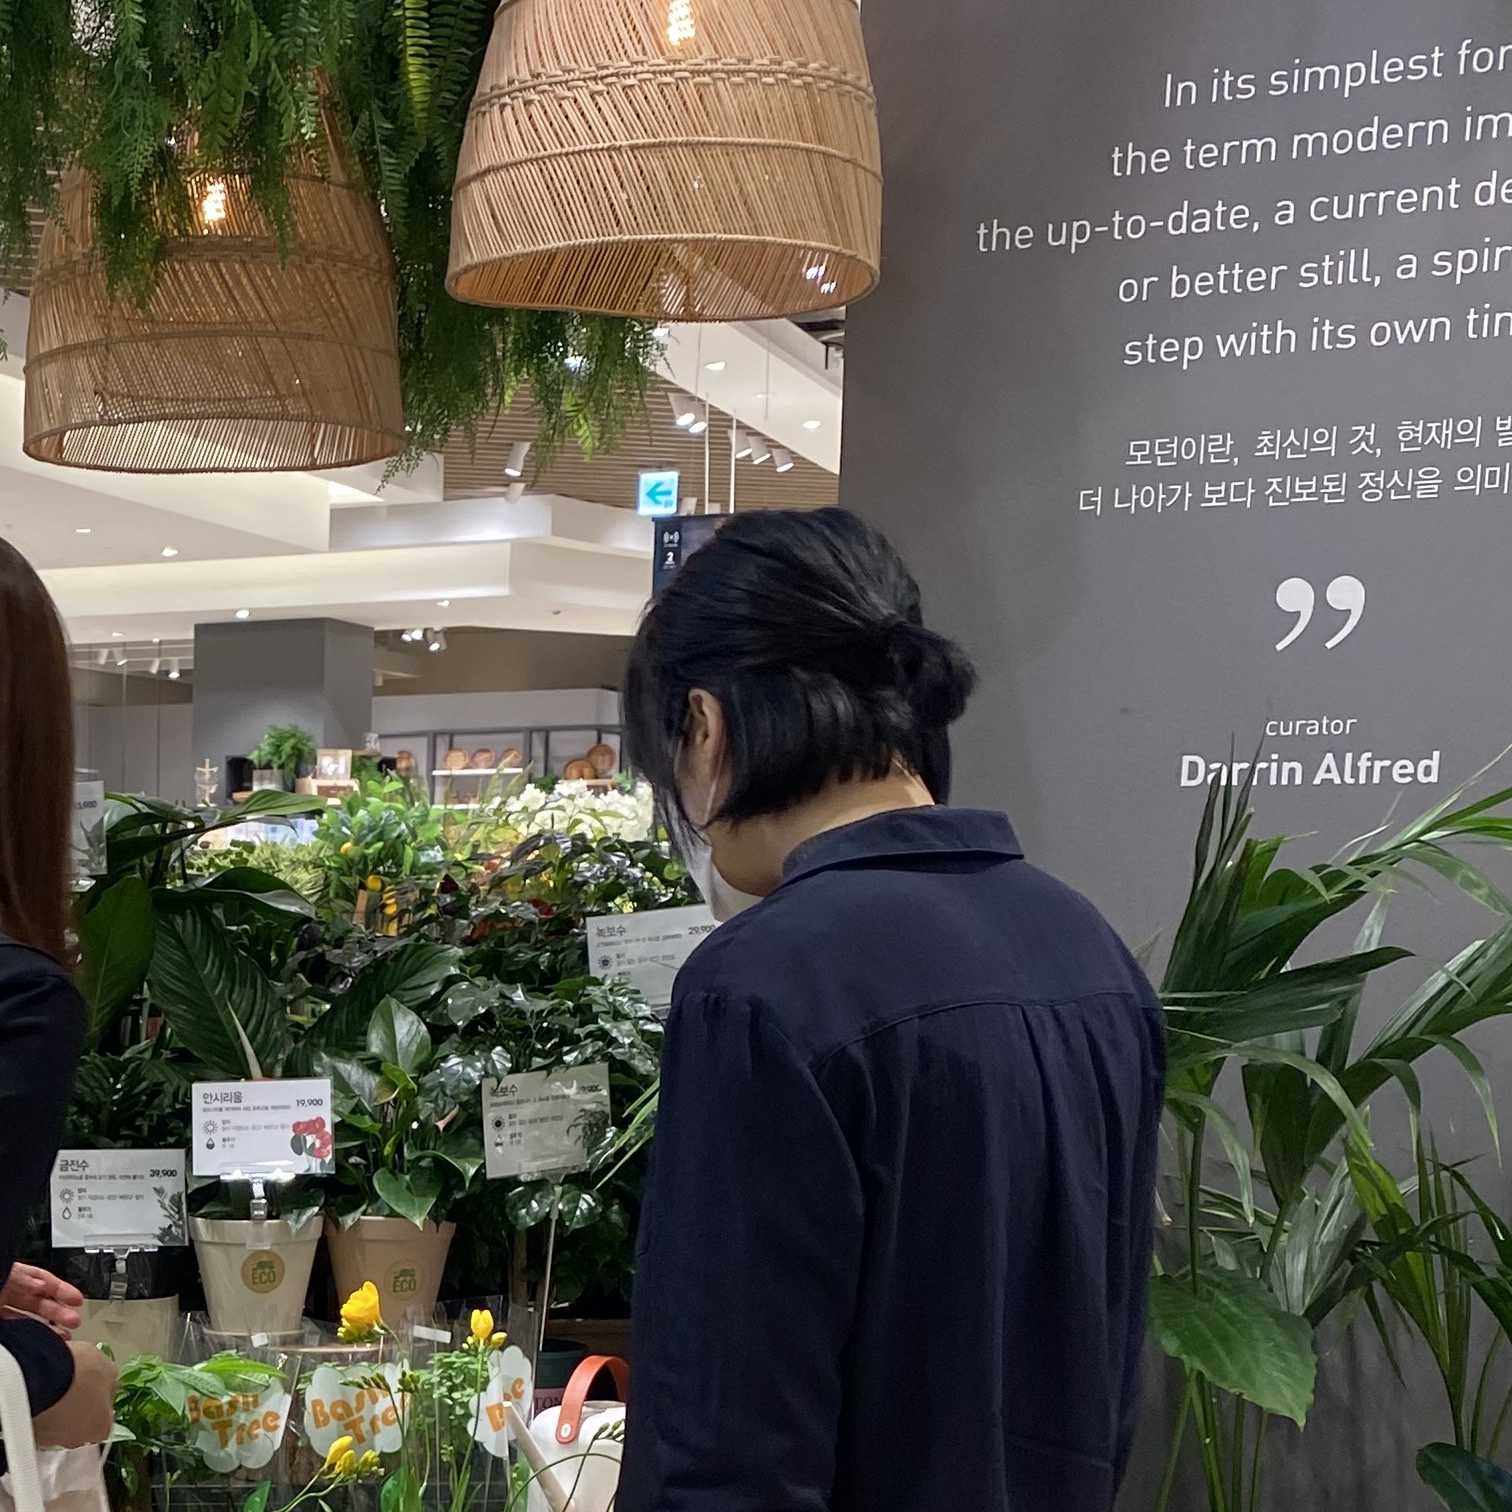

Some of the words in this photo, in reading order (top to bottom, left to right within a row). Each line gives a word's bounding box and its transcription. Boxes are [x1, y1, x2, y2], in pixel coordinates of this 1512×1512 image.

[1165, 73, 1197, 108] In
[1212, 67, 1256, 103] its
[1268, 45, 1444, 99] simplest
[1111, 141, 1171, 177] the
[1182, 137, 1277, 170] term
[1291, 115, 1449, 160] modern
[976, 218, 1034, 252] the
[1047, 200, 1260, 255] up-to-date,
[1274, 200, 1295, 226] a
[1309, 177, 1461, 222] current
[1118, 276, 1159, 303] or
[1171, 262, 1288, 299] better
[1299, 248, 1381, 288] still,
[1396, 254, 1418, 280] a
[1123, 333, 1204, 371] step
[1216, 319, 1297, 358] with
[1311, 316, 1356, 351] its
[1370, 316, 1451, 347] own
[1125, 433, 1239, 467] 모던이란,
[1255, 426, 1338, 460] 최신의
[1349, 423, 1382, 458] 것,
[1397, 416, 1482, 452] 현재의
[1079, 485, 1102, 517] 더
[1114, 481, 1193, 515] 나아가
[1200, 478, 1256, 509] 보다
[1265, 472, 1347, 507] 진보된
[1358, 467, 1443, 502] 정신을
[1265, 715, 1358, 737] curator
[1179, 752, 1304, 788] Darrin
[1311, 749, 1441, 786] Alfred
[296, 1098, 324, 1108] 19,900
[251, 1270, 276, 1285] ECO
[392, 1278, 416, 1293] ECO
[210, 1409, 281, 1450] Tree
